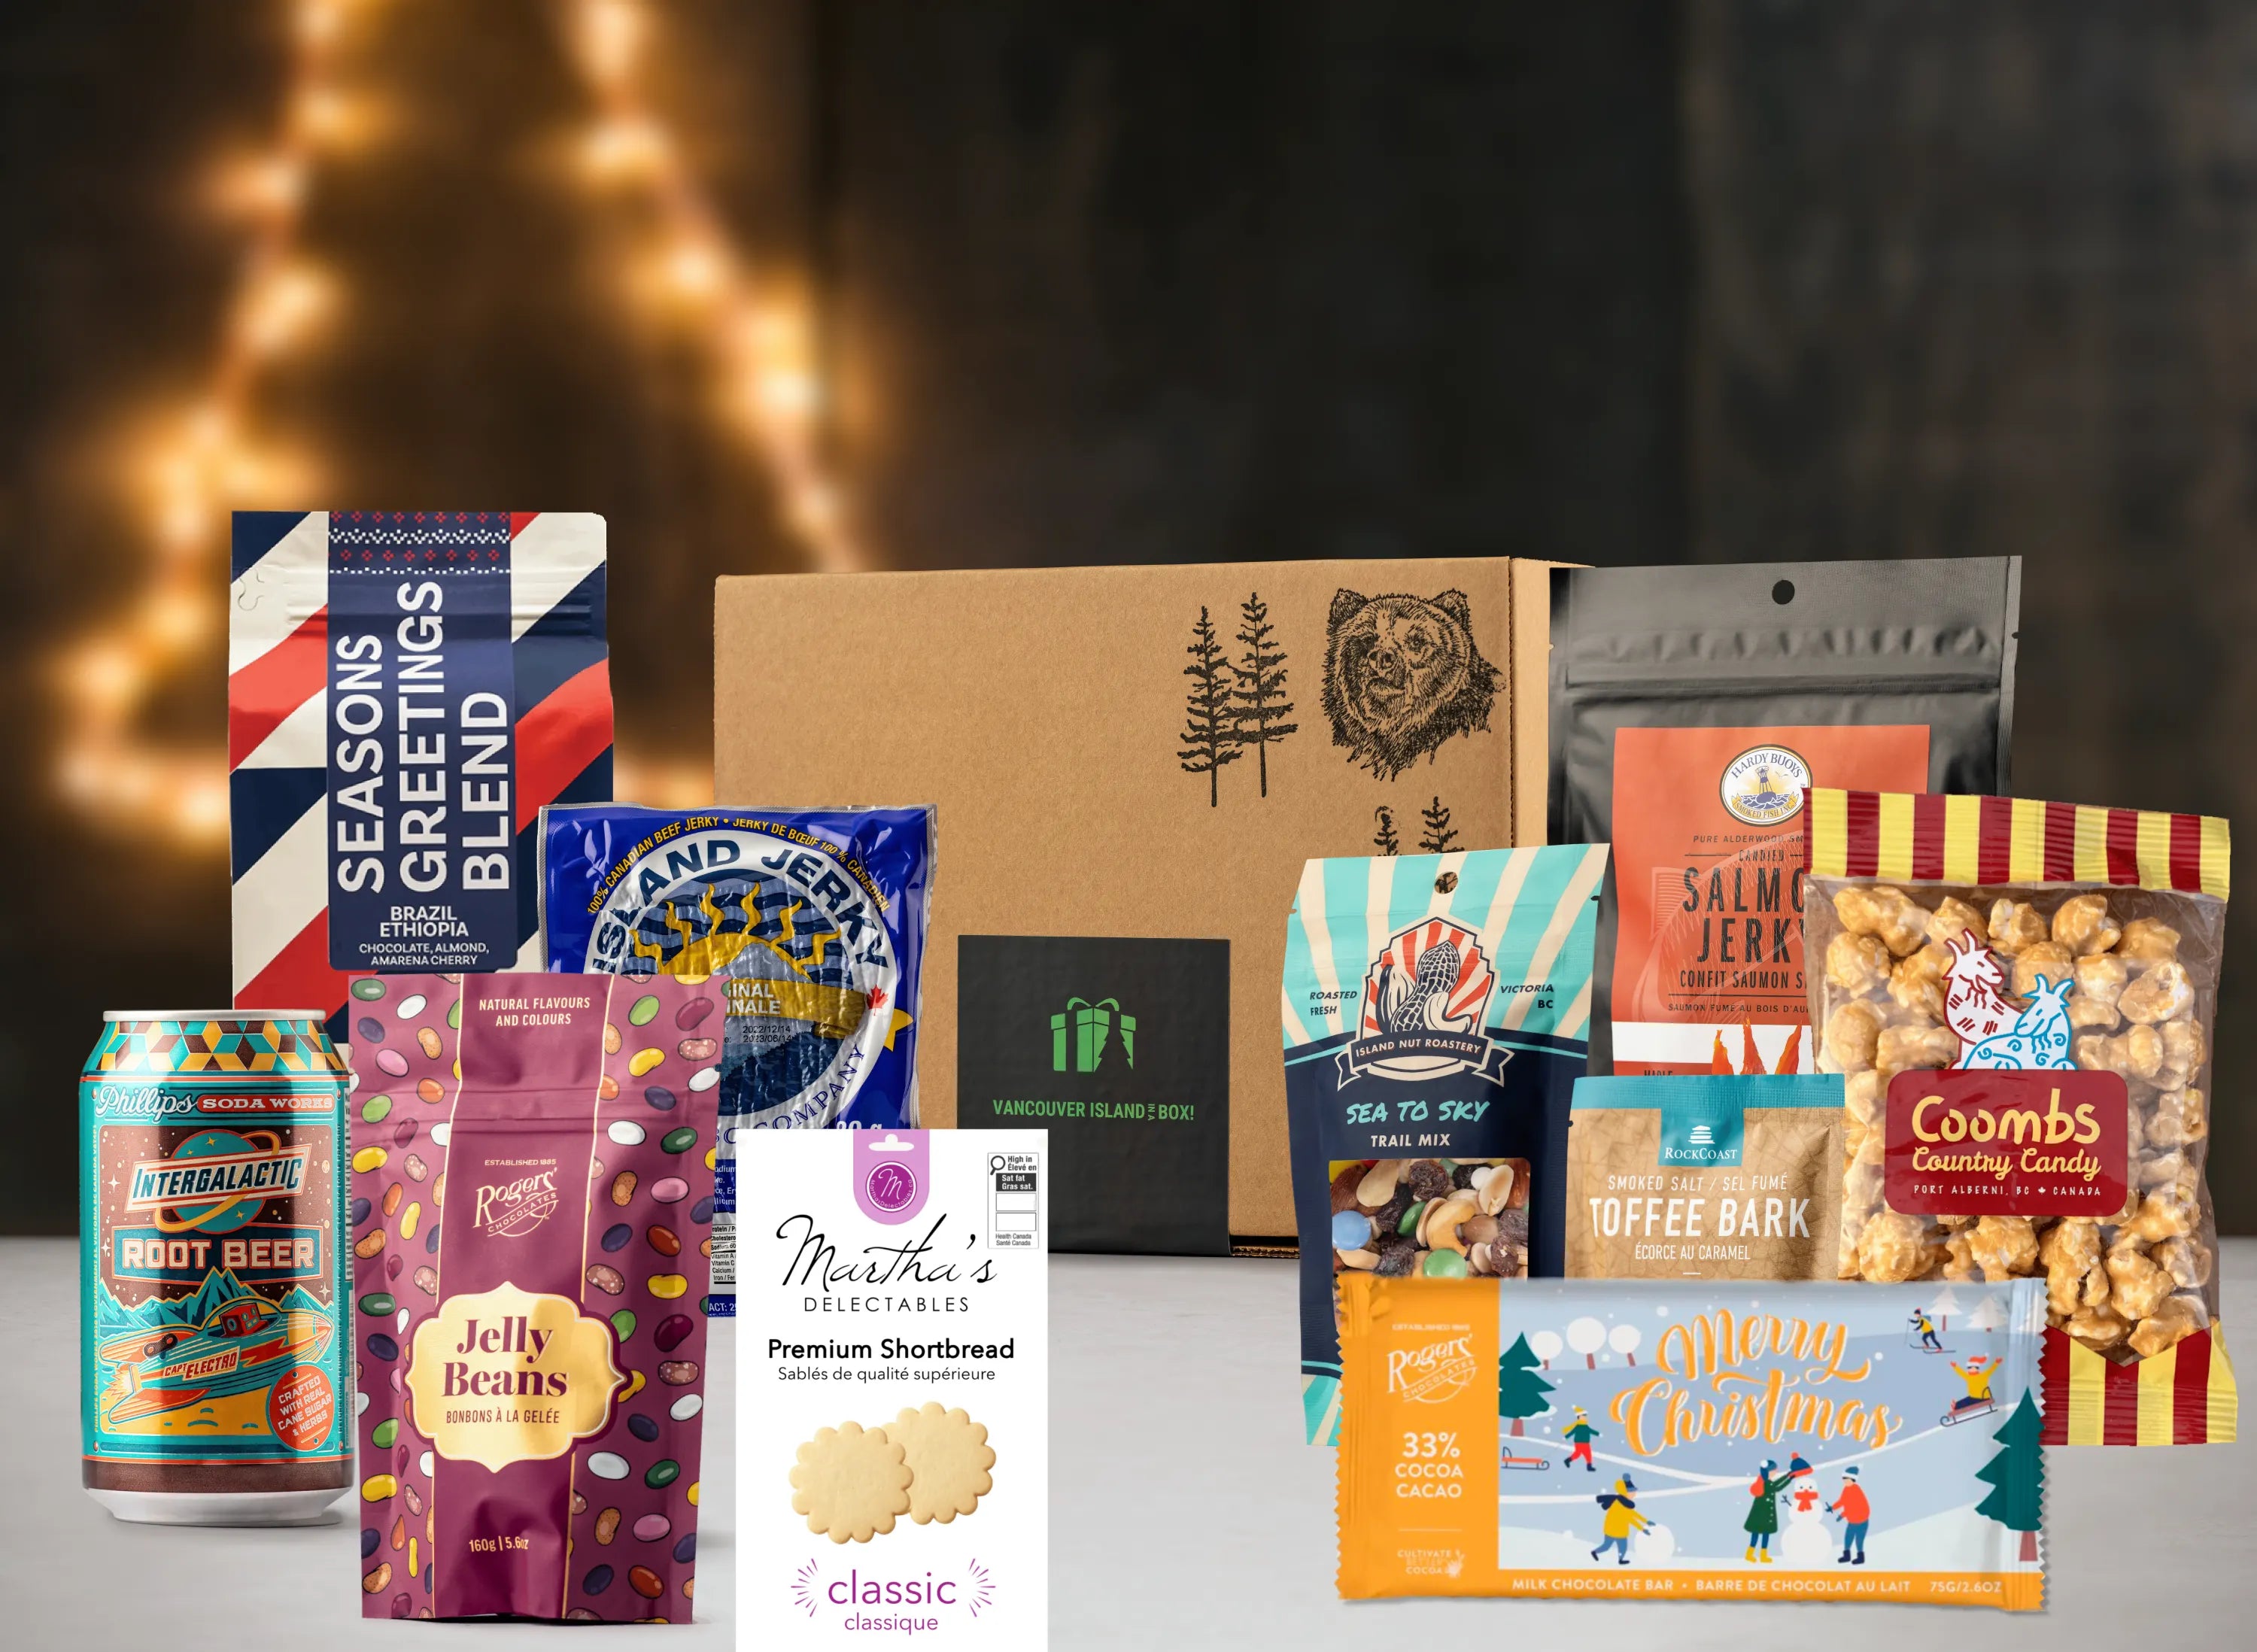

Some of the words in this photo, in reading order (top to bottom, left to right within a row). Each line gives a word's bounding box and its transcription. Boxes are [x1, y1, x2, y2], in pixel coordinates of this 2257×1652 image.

[396, 581, 447, 892] GREETINGS
[336, 635, 384, 893] SEASONS
[1731, 753, 1768, 779] HARDY
[1770, 753, 1803, 778] BUOYS
[460, 691, 510, 891] BLEND
[1735, 803, 1761, 818] SMOKED
[1763, 810, 1779, 818] FISH
[587, 887, 609, 914] 100%
[605, 837, 654, 888] CANADIAN
[653, 821, 681, 844] BEEF
[685, 816, 719, 832] JERKY
[732, 818, 769, 831] JERKY
[770, 823, 787, 837] DE
[788, 828, 820, 846] BŒUF
[821, 841, 837, 855] 100
[839, 849, 849, 864] %
[847, 858, 891, 913] CANADIEN
[1739, 849, 1785, 862] CANDIED
[1682, 867, 1803, 913] SALMO
[390, 906, 457, 922] BRAZIL
[593, 840, 741, 972] ISLAND
[761, 849, 889, 969] JERKY
[380, 922, 469, 938] ETHIOPIA
[1697, 918, 1804, 964] JERK
[359, 943, 434, 955] CHOCOLATE,
[436, 943, 490, 955] ALMOND,
[370, 955, 429, 966] AMARENA
[431, 955, 478, 966] CHERRY
[1500, 984, 1554, 994] VICTORIA
[1680, 970, 1726, 988] CONFIT
[1732, 970, 1788, 988] SAUMON
[479, 998, 530, 1011] NATURAL
[533, 997, 591, 1010] FLAVOURS
[1310, 991, 1357, 1001] ROASTED
[1538, 1000, 1554, 1009] BC
[495, 1014, 520, 1026] AND
[522, 1013, 572, 1026] COLOURS
[1310, 1006, 1337, 1016] FRESH
[1669, 1004, 1706, 1012] SAUMON
[1356, 1041, 1395, 1058] ISLAND
[1399, 1038, 1421, 1049] NUT
[1425, 1038, 1482, 1054] ROASTERY
[96, 1086, 193, 1123] Phillips
[202, 1098, 266, 1109] SODA
[269, 1098, 333, 1109] WORKS
[993, 1099, 1085, 1117] VANCOUVER
[1090, 1103, 1145, 1119] ISLAND
[1159, 1104, 1194, 1120] BOX!
[1347, 1101, 1389, 1124] SEA
[1398, 1101, 1429, 1121] TO
[1438, 1100, 1490, 1122] SKY
[1912, 1088, 2101, 1144] Coombs
[1371, 1134, 1411, 1147] TRAIL
[1418, 1134, 1450, 1146] MIX
[1008, 1155, 1023, 1164] High
[1912, 1146, 2013, 1181] Country
[2020, 1147, 2101, 1182] Candy
[878, 1168, 902, 1200] M
[1608, 1175, 1663, 1190] SMOKED
[1671, 1177, 1703, 1191] SALT
[1723, 1177, 1745, 1191] SEL
[1752, 1172, 1788, 1190] FUMÉ
[1914, 1185, 1943, 1194] PORT
[2017, 1186, 2030, 1195] BC
[2053, 1186, 2101, 1196] CANADA
[472, 1167, 557, 1228] Rogers'
[488, 1192, 557, 1232] CHOCOLATES
[1590, 1198, 1706, 1237] TOFFEE
[1718, 1198, 1811, 1238] BARK
[123, 1238, 211, 1268] ROOT
[223, 1238, 314, 1268] BEER
[776, 1213, 998, 1292] Martha's
[1635, 1242, 1676, 1259] ÉCORCE
[1681, 1245, 1694, 1259] AU
[1699, 1245, 1751, 1261] CARAMEL
[804, 1297, 969, 1312] DELECTABLES
[457, 1316, 554, 1363] Jelly
[769, 1338, 872, 1359] Premium
[881, 1338, 1014, 1359] Shortbread
[1656, 1308, 1871, 1384] Merry
[165, 1363, 187, 1377] CAPT
[185, 1353, 238, 1379] ELECTRO
[1387, 1333, 1473, 1393] Rogers'
[442, 1362, 567, 1397] Beans
[779, 1366, 828, 1380] Sablés
[833, 1367, 852, 1380] de
[857, 1366, 909, 1384] qualité
[914, 1366, 995, 1384] supérieure
[278, 1375, 320, 1405] CRAFTED
[280, 1399, 303, 1416] WITH
[304, 1387, 325, 1403] REAL
[278, 1413, 304, 1431] CANE
[305, 1393, 332, 1416] SUGAR
[446, 1410, 492, 1423] BONBONS
[495, 1407, 503, 1423] À
[506, 1411, 519, 1423] LA
[524, 1408, 560, 1423] GELÉE
[1608, 1368, 1903, 1456] Christmas
[293, 1429, 299, 1437] &
[301, 1411, 328, 1433] HERBS
[1402, 1432, 1460, 1459] 33%
[1396, 1463, 1463, 1478] COCOA
[1396, 1483, 1462, 1499] CACAO
[469, 1538, 497, 1554] 160g
[506, 1536, 529, 1550] 5.6oz
[828, 1569, 956, 1605] classic
[1512, 1578, 1547, 1590] MILK
[1551, 1578, 1641, 1590] CHOCOLATE
[1645, 1579, 1673, 1590] BAR
[1696, 1580, 1744, 1592] BARRE
[1748, 1581, 1767, 1592] DE
[1771, 1581, 1852, 1593] CHOCOLAT
[1855, 1581, 1876, 1593] AU
[1880, 1581, 1910, 1593] LAIT
[844, 1612, 939, 1635] classique
